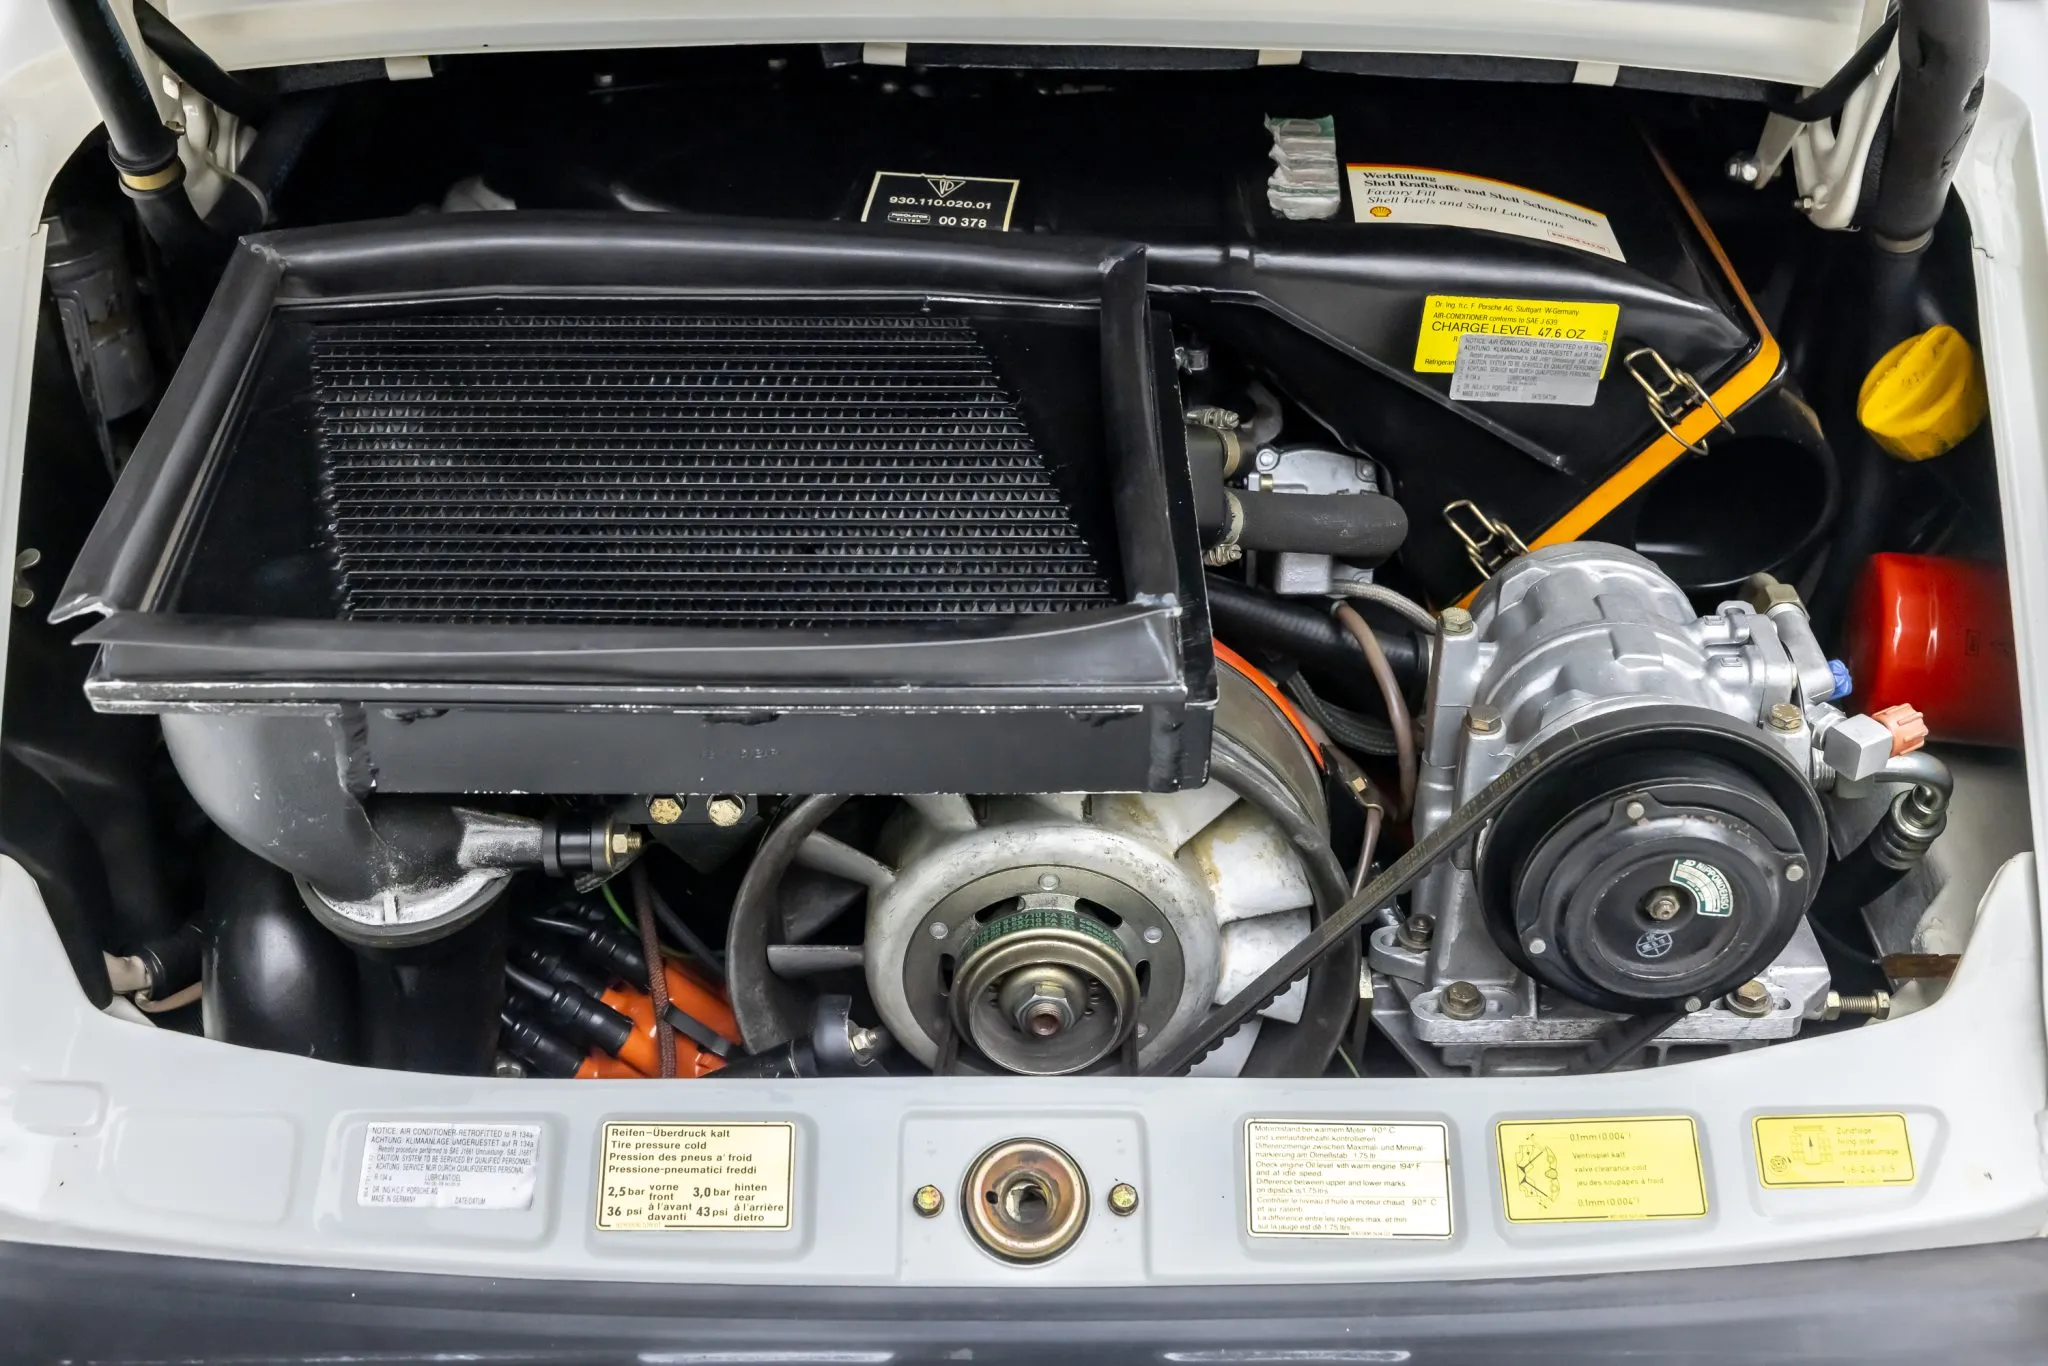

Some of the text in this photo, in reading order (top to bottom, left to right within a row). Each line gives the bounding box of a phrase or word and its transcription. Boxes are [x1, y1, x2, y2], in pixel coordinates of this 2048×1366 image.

[1363, 173, 1436, 182] Werkfüllung
[889, 196, 991, 209] 930.110.020.01
[1400, 181, 1460, 191] Kraftstoffe
[1490, 191, 1519, 203] Shell
[1523, 200, 1598, 227] Schmierstoffe
[1467, 202, 1497, 213] Shell
[1502, 209, 1563, 228] Lubricants
[939, 216, 987, 228] 00 378
[1545, 308, 1579, 316] W-Germany
[1432, 321, 1489, 333] CHARGE
[1492, 324, 1532, 336] LEVEL
[1566, 329, 1586, 339] OZ
[413, 1128, 456, 1136] CONDITIONER
[459, 1129, 502, 1137] RETROFITTED
[612, 1127, 730, 1137] Reifen-Überdruck kalt
[406, 1137, 450, 1145] KLIMAANLAGE
[659, 1153, 676, 1161] des
[728, 1154, 752, 1162] froid
[609, 1165, 756, 1174] Pressione-pneumatici freddi
[608, 1187, 626, 1198] 2,5
[693, 1187, 730, 1198] 3,0 bar
[607, 1206, 642, 1216] 36 psi
[696, 1207, 728, 1217] 43 psi
[734, 1213, 764, 1221] dietro
